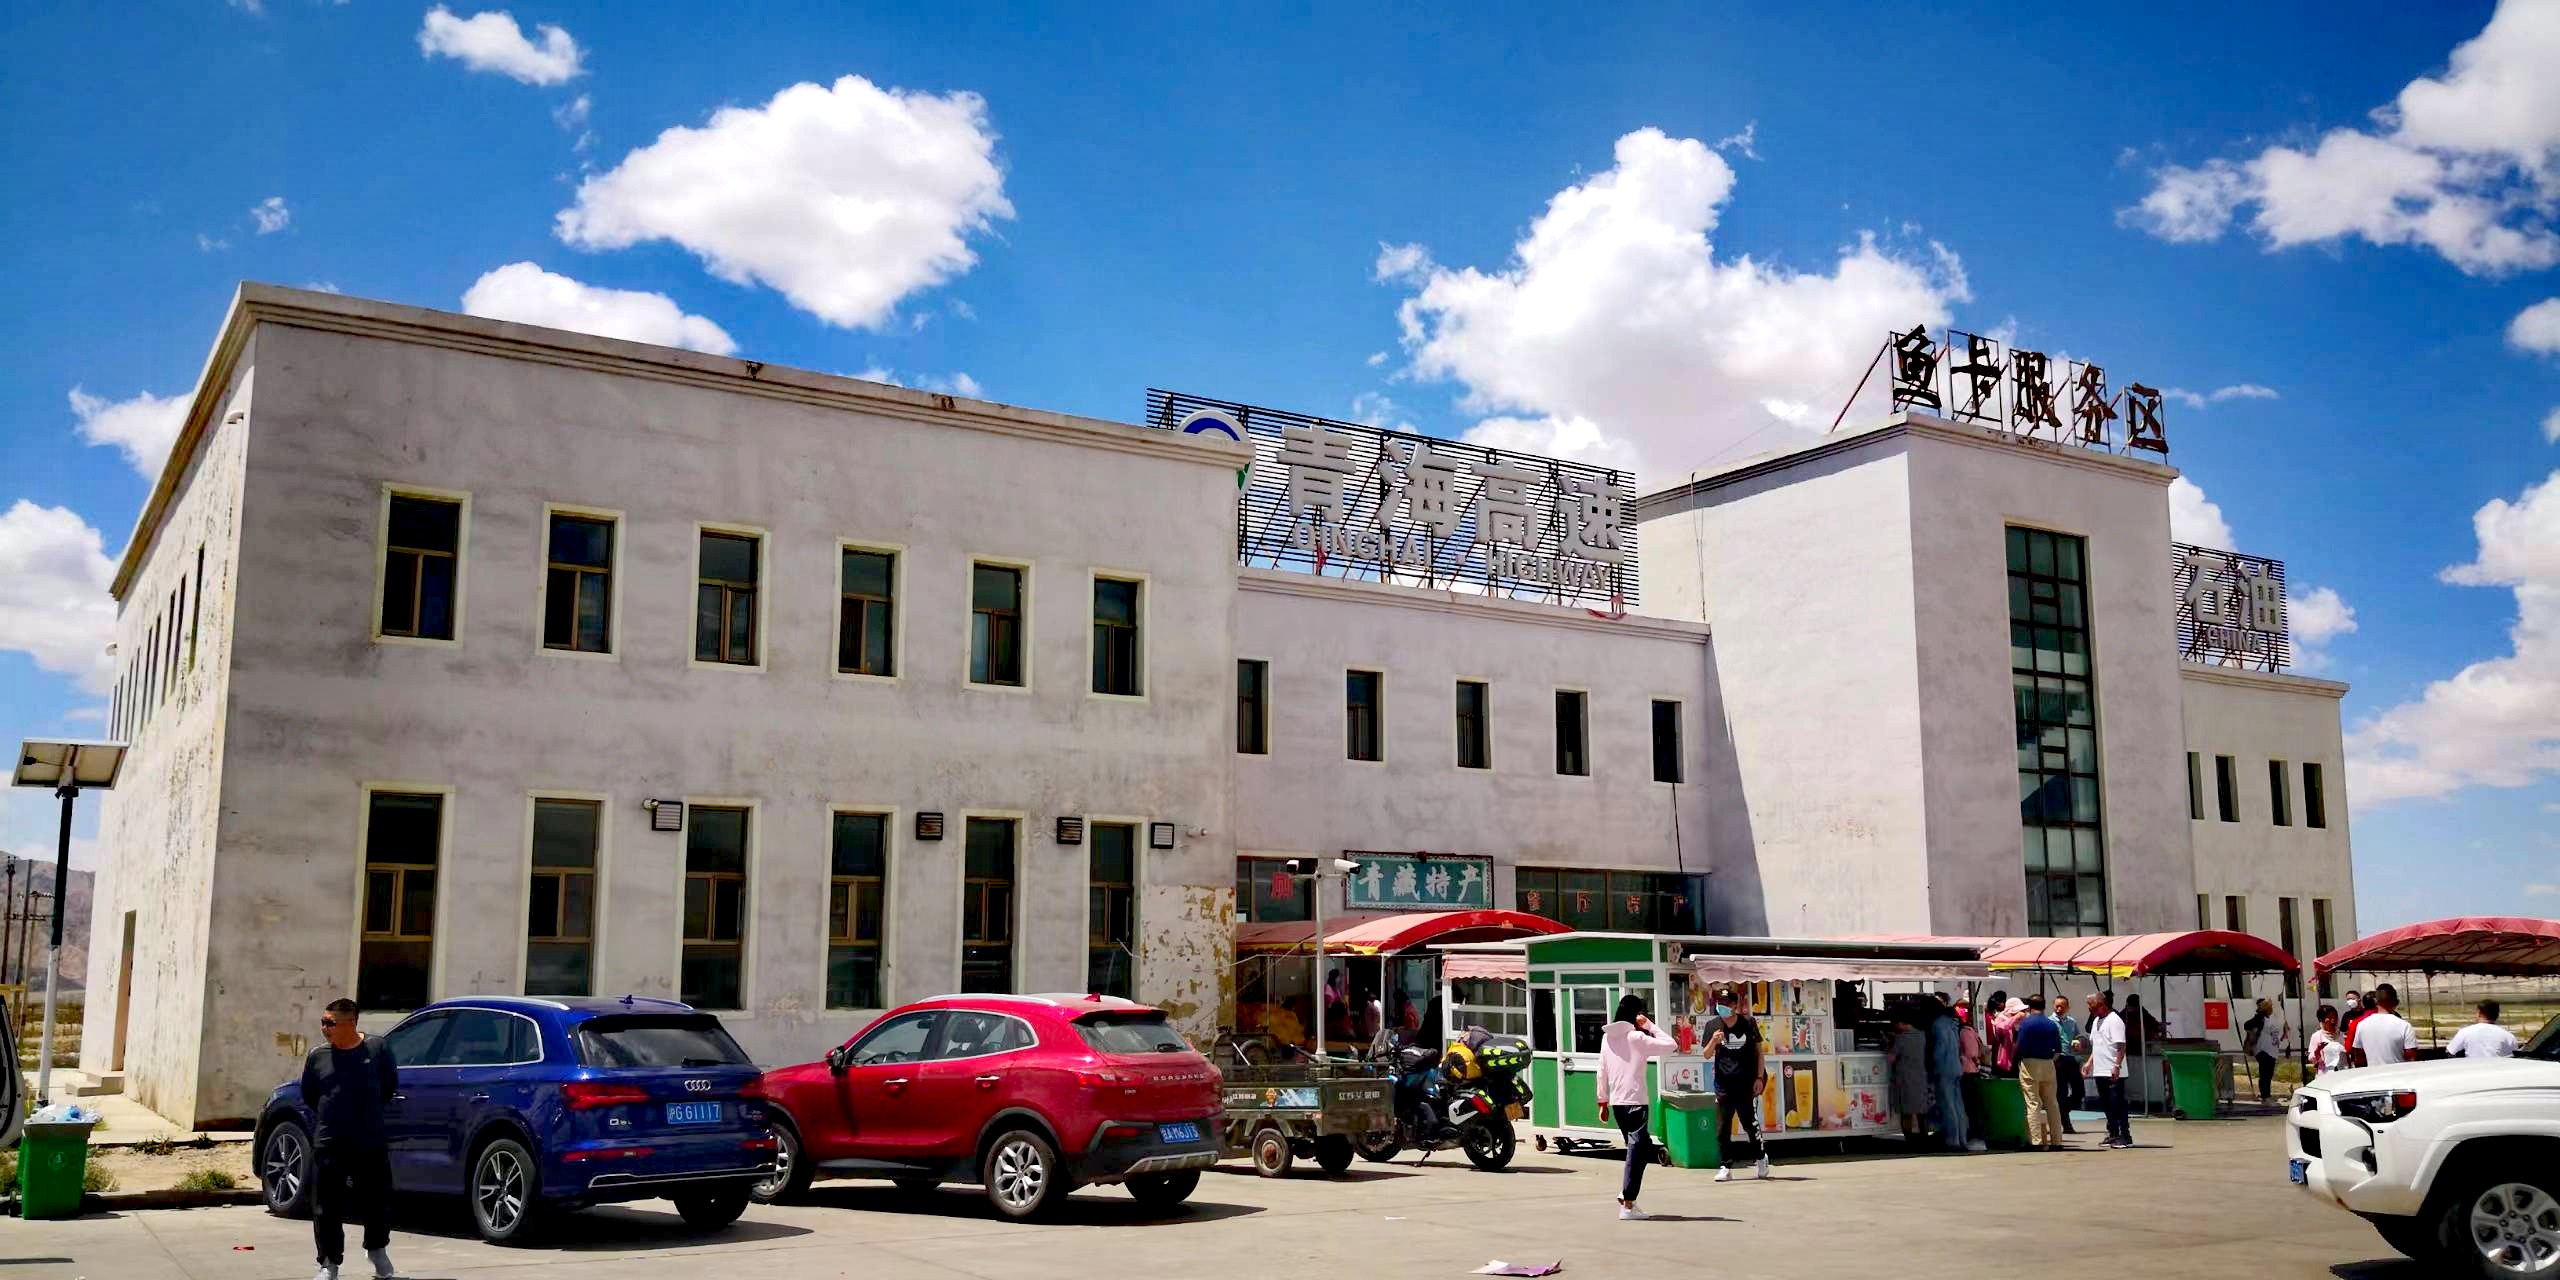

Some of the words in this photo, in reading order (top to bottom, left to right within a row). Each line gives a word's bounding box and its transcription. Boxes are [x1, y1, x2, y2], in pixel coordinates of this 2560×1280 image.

[1892, 324, 2169, 454] 鱼卡服务区
[1276, 424, 1625, 564] 青海高速
[1291, 522, 1433, 567] QINGHAI
[1485, 549, 1612, 590] HIGHWAY
[2183, 554, 2282, 634] 石油
[1357, 860, 1481, 902] 青藏特产
